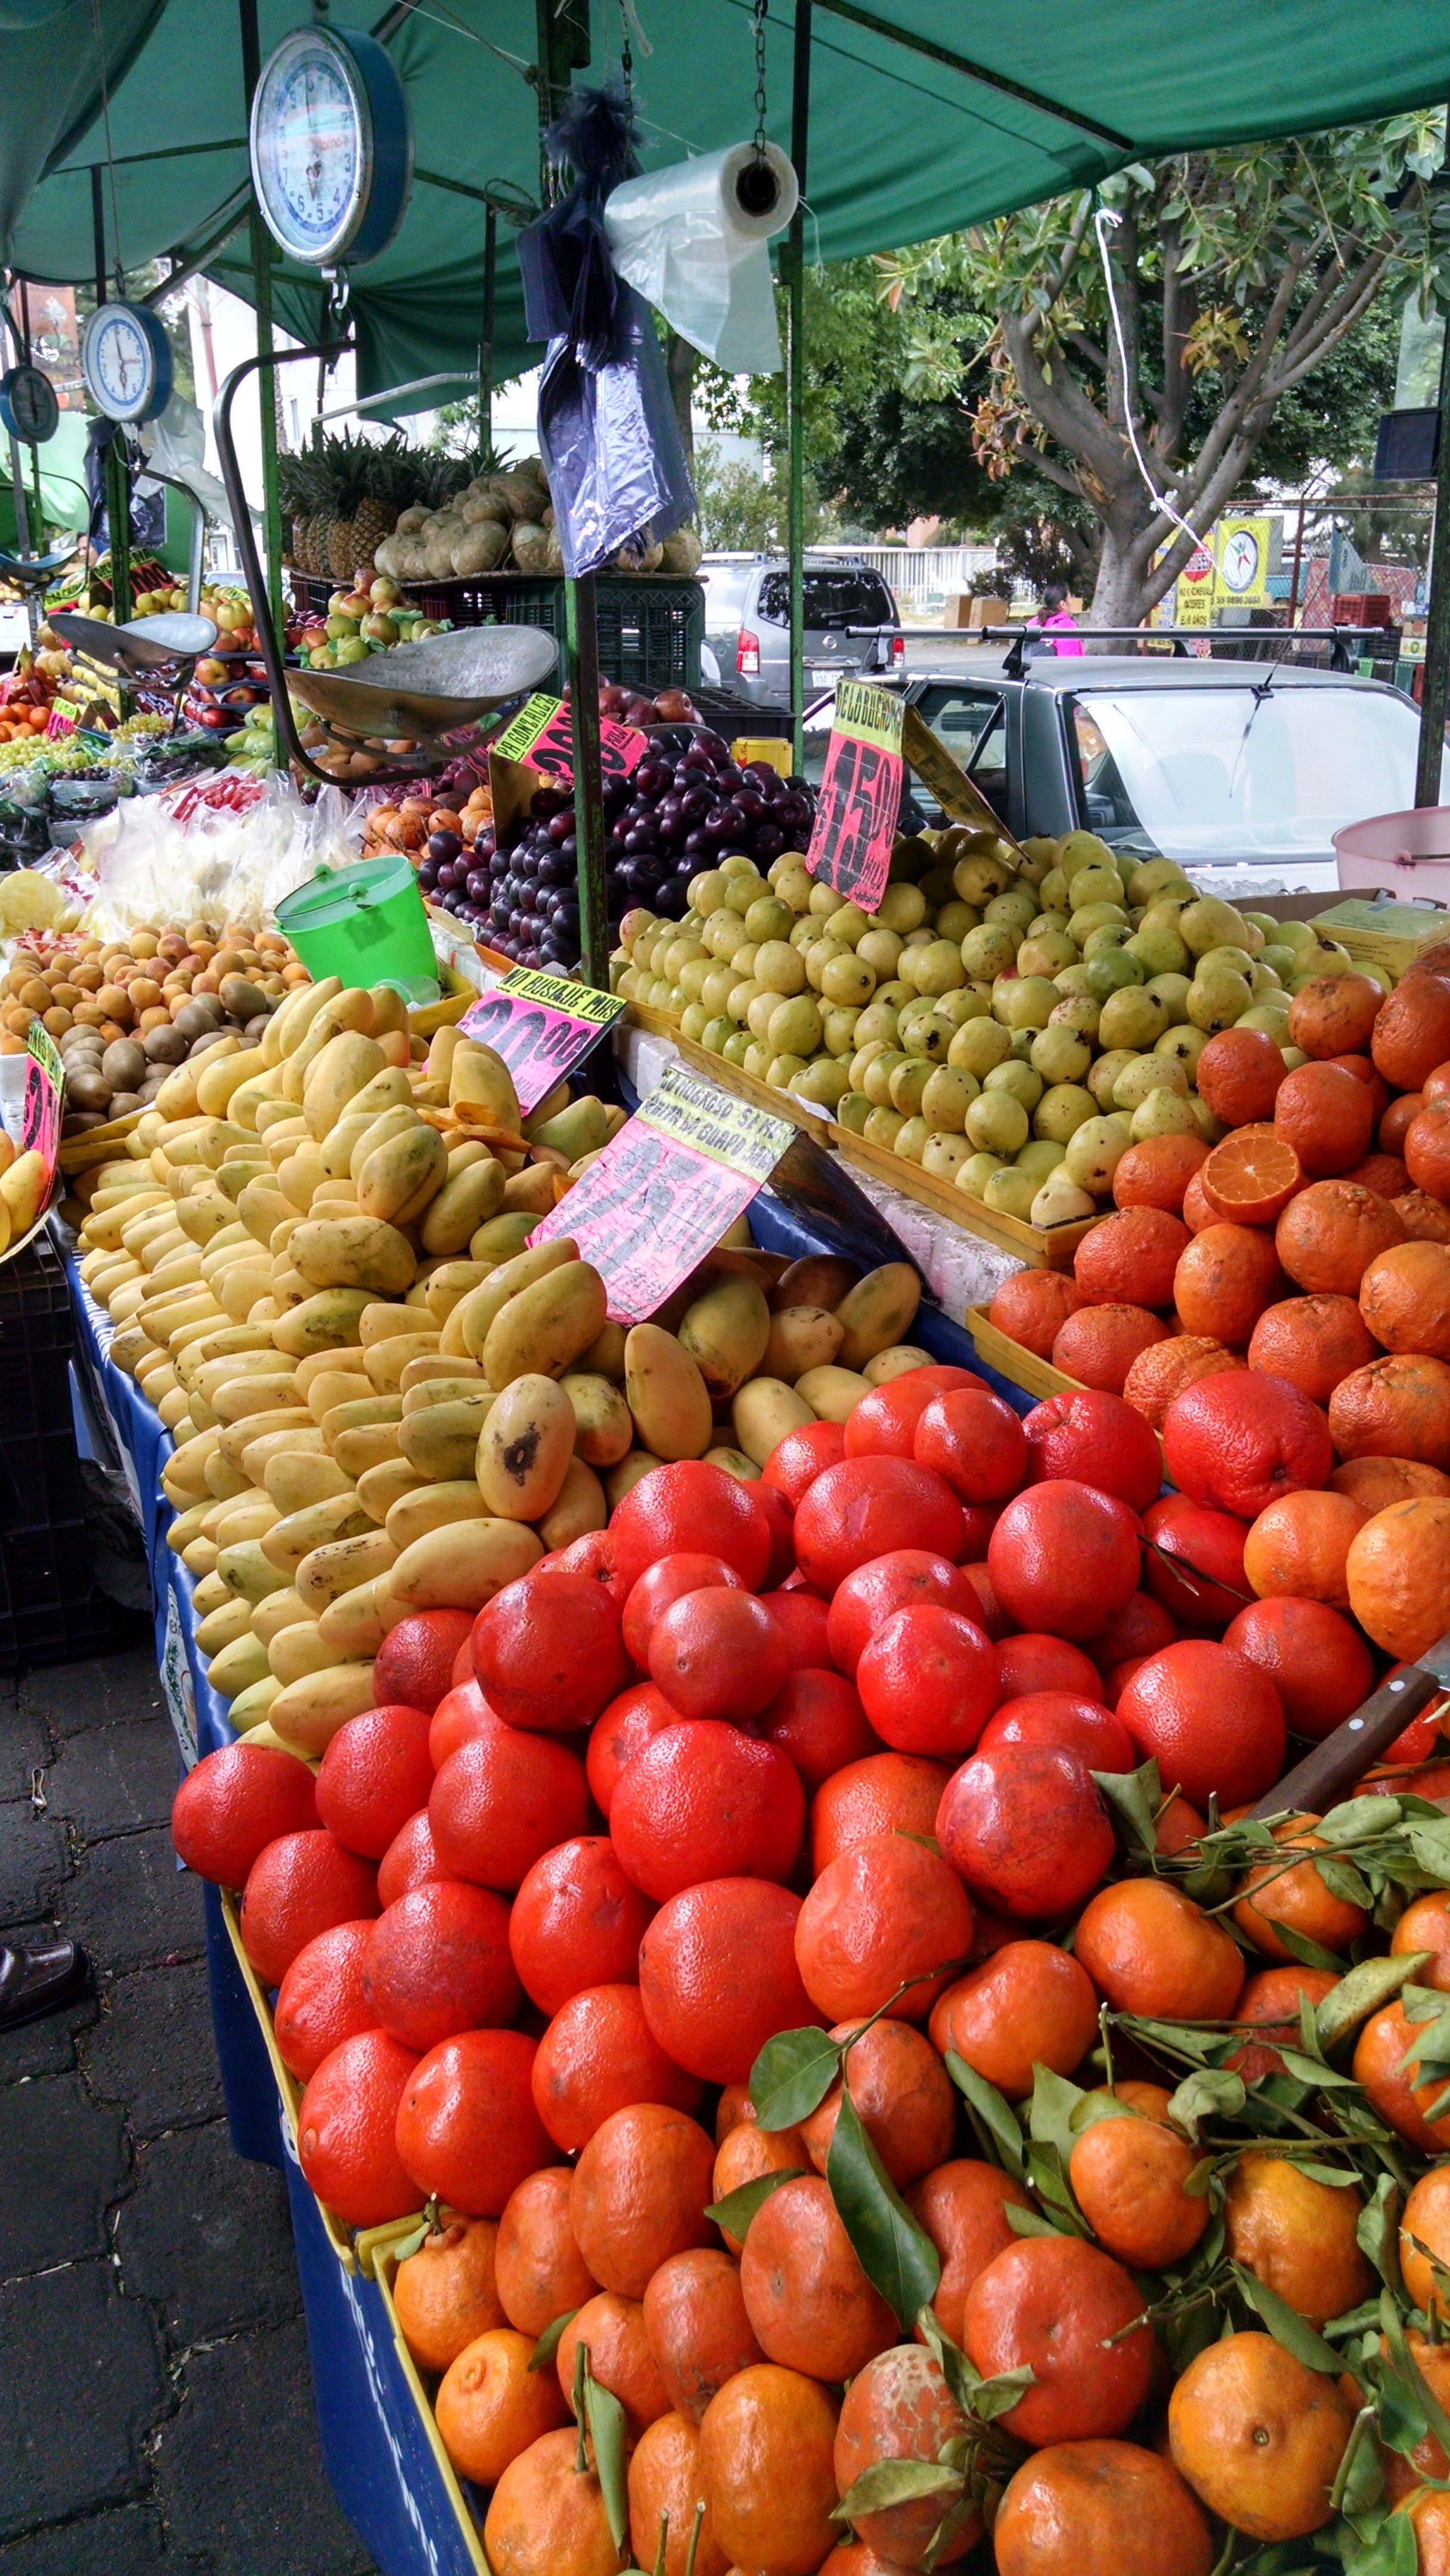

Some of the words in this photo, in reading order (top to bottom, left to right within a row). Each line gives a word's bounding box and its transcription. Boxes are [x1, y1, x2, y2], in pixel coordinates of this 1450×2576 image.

[344, 153, 351, 172] 3
[298, 195, 305, 213] 6
[333, 187, 341, 205] 4
[317, 203, 324, 221] 5
[605, 726, 628, 748] KILO
[499, 968, 529, 989] NO
[583, 994, 623, 1020] MAS
[696, 1122, 746, 1157] GUAPO
